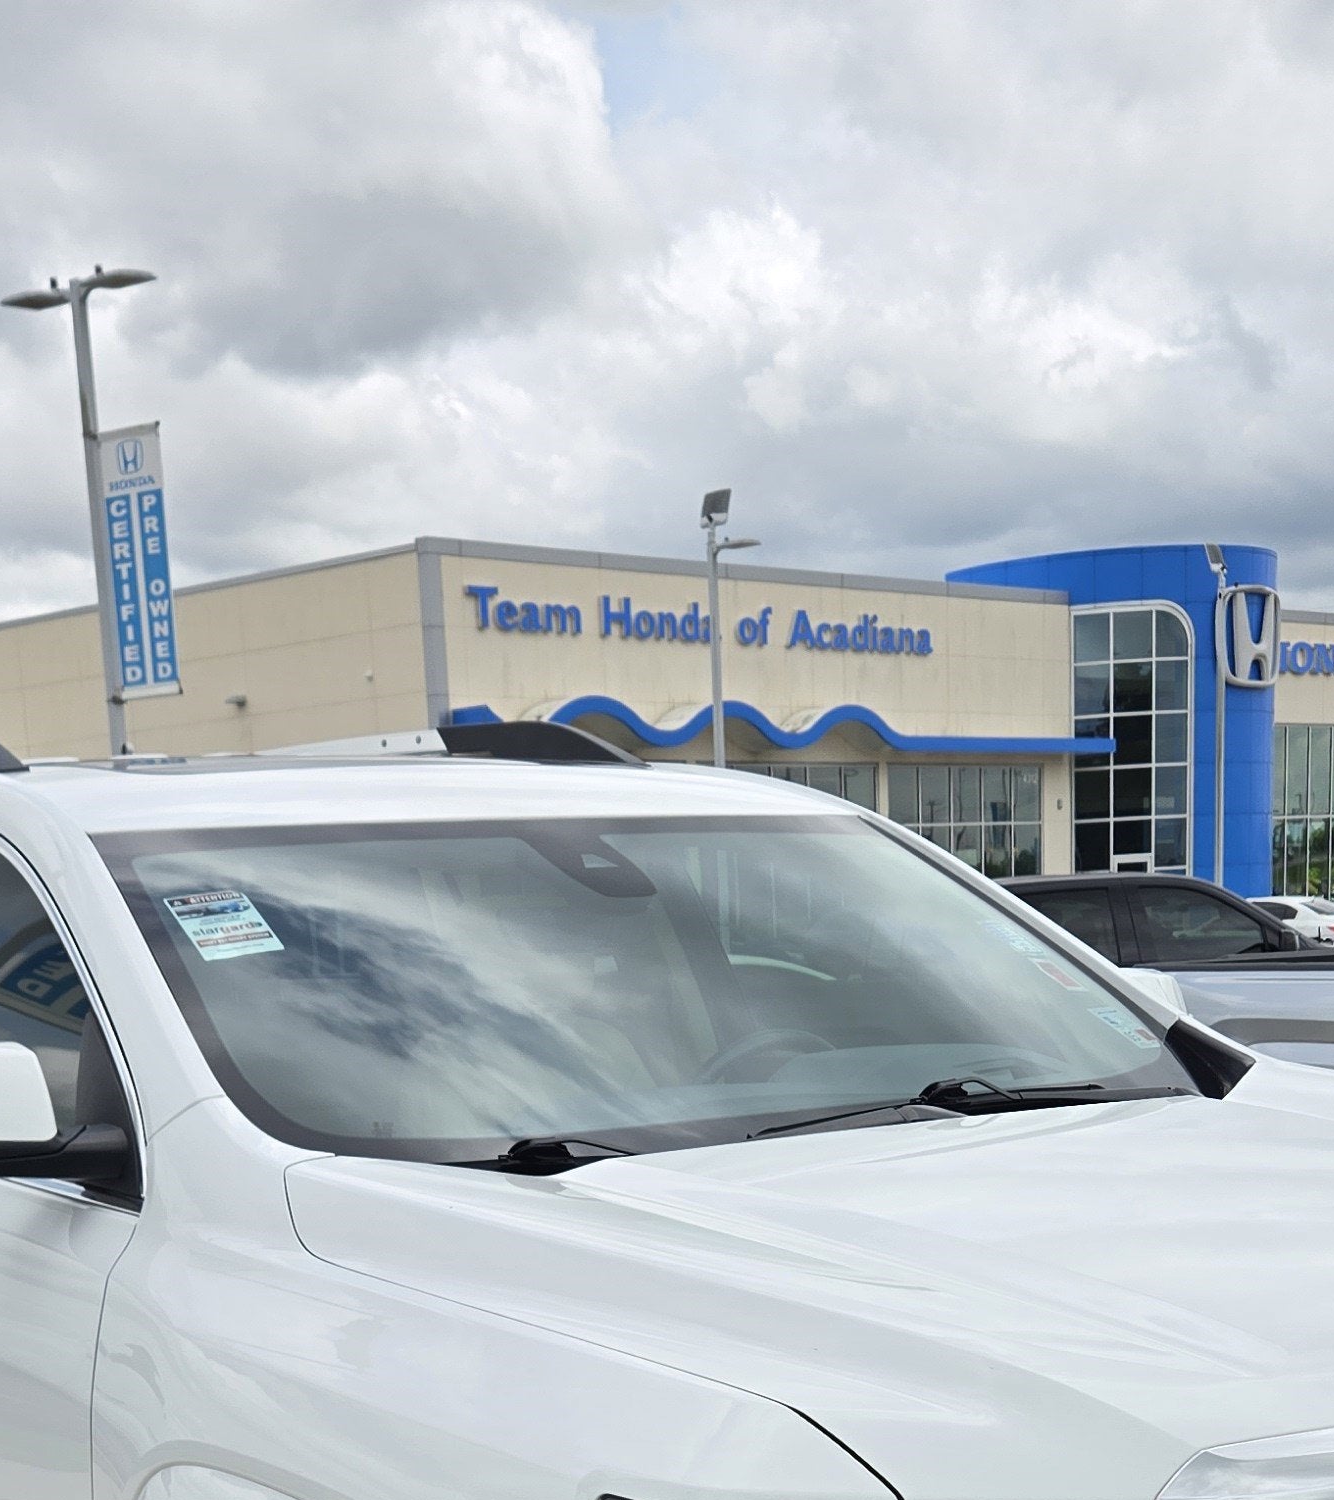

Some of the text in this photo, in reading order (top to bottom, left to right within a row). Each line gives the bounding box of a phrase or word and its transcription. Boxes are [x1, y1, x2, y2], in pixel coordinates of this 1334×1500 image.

[108, 474, 156, 491] HONDA
[109, 499, 143, 684] CERTIFIED
[142, 495, 173, 679] PRE OWNED
[464, 584, 582, 635] Team
[737, 606, 773, 647] of
[787, 608, 934, 656] Acadiana
